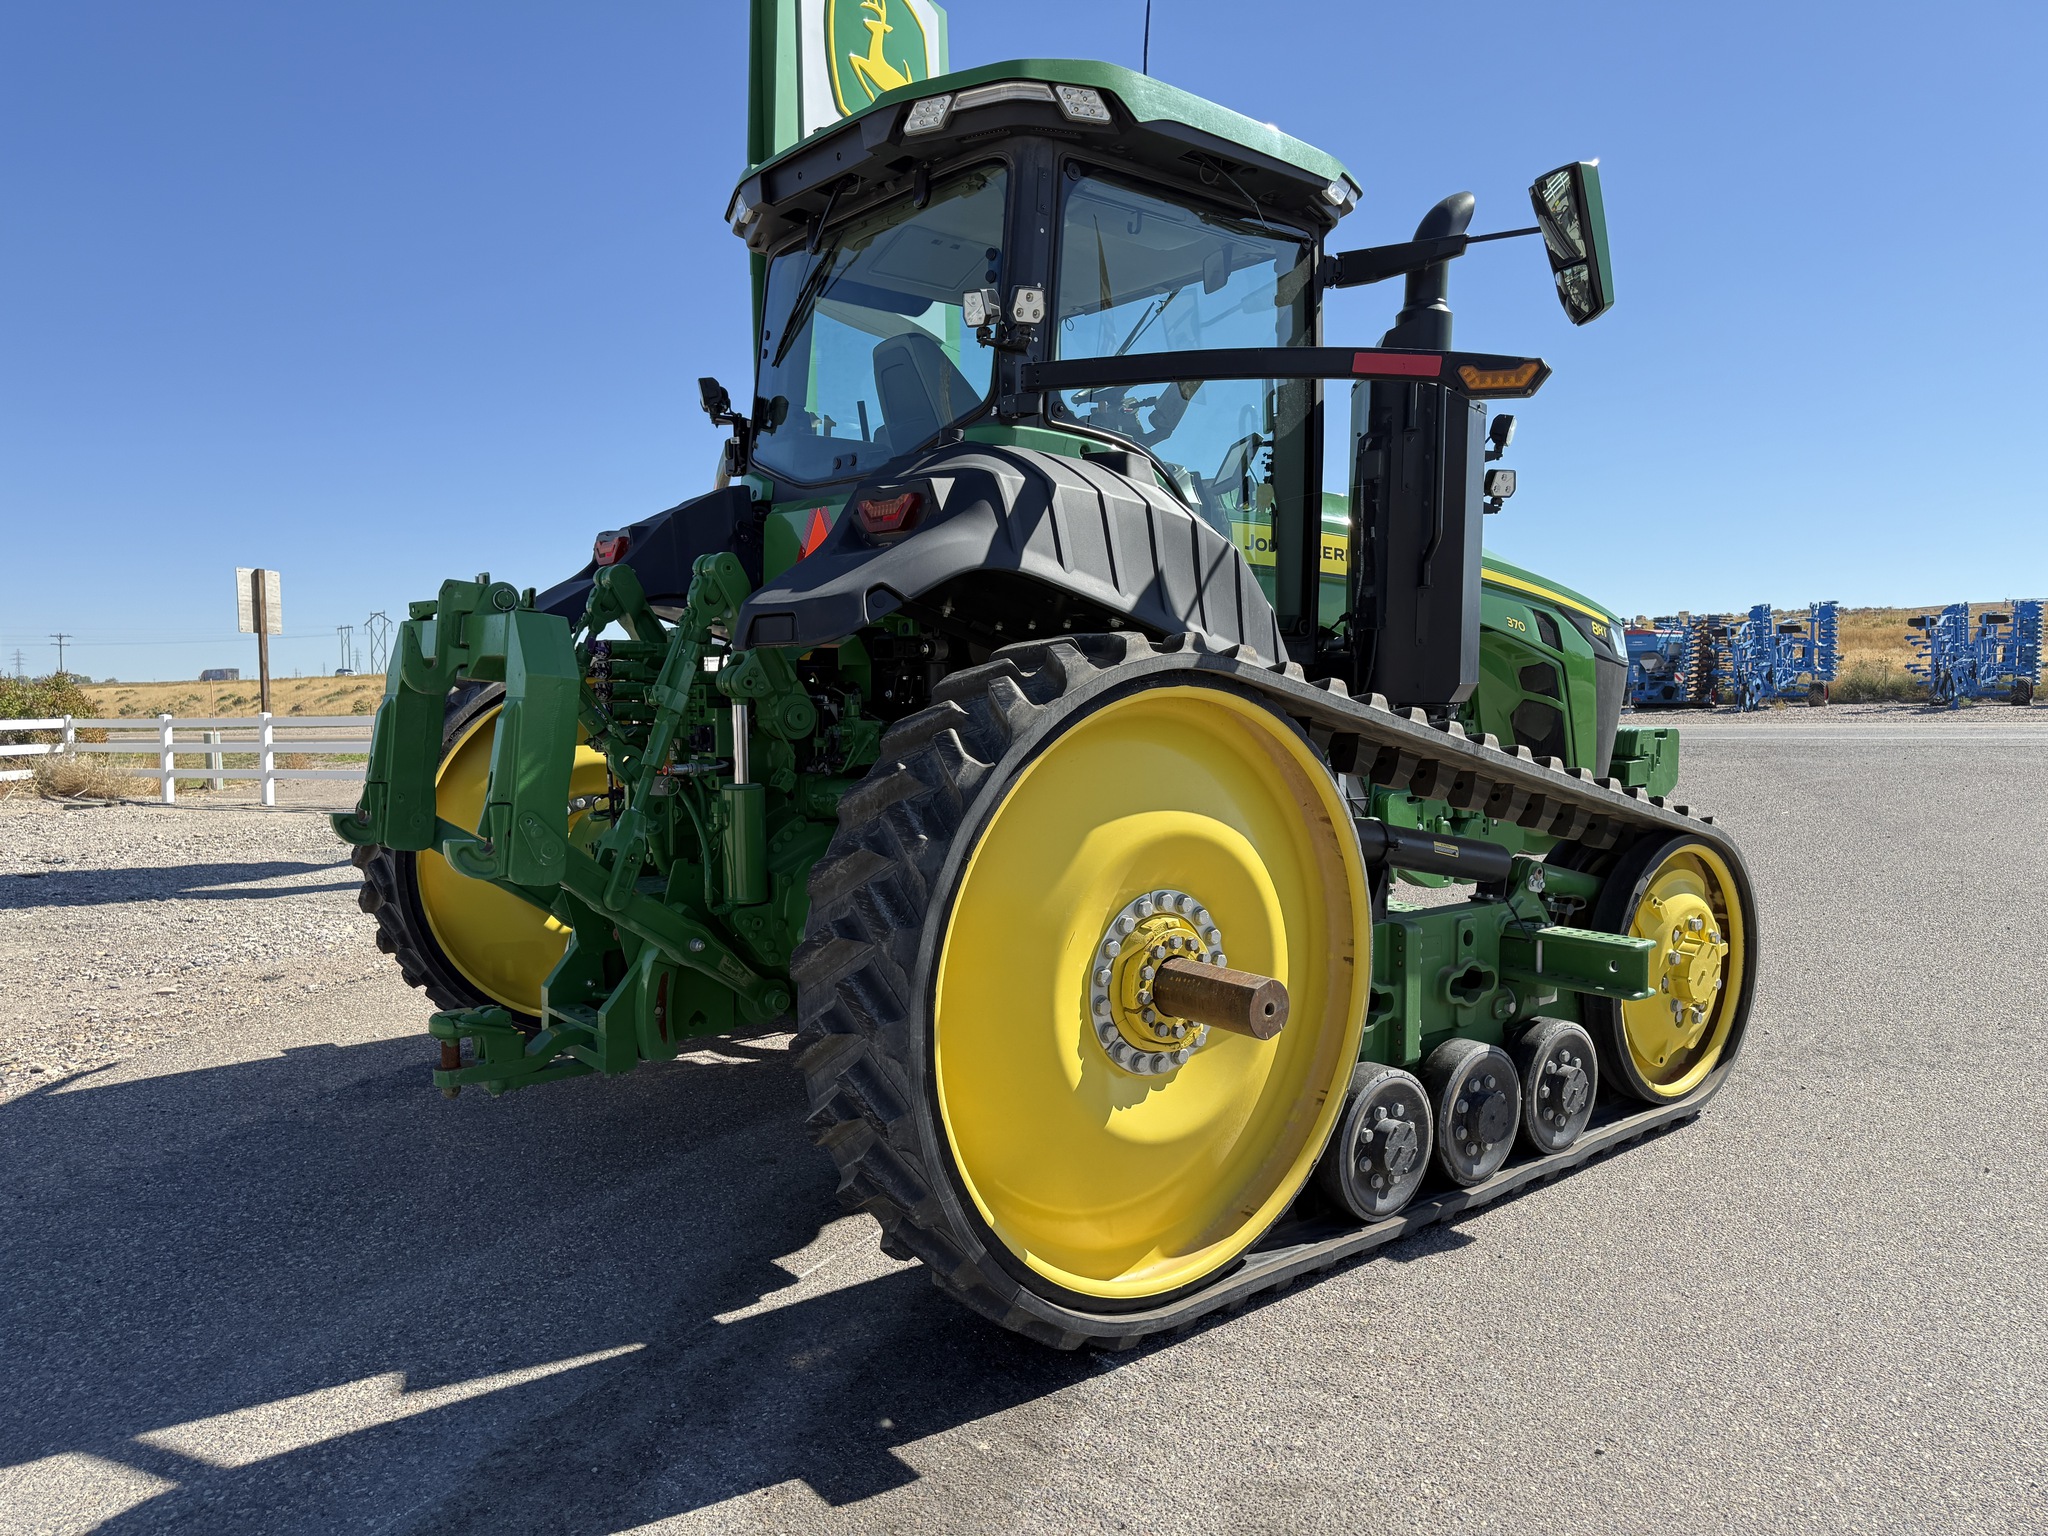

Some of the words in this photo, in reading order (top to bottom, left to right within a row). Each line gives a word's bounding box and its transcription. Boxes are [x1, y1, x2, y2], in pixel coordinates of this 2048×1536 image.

[1245, 533, 1276, 552] JO
[1506, 616, 1526, 632] 370
[1591, 620, 1607, 638] 8RT
